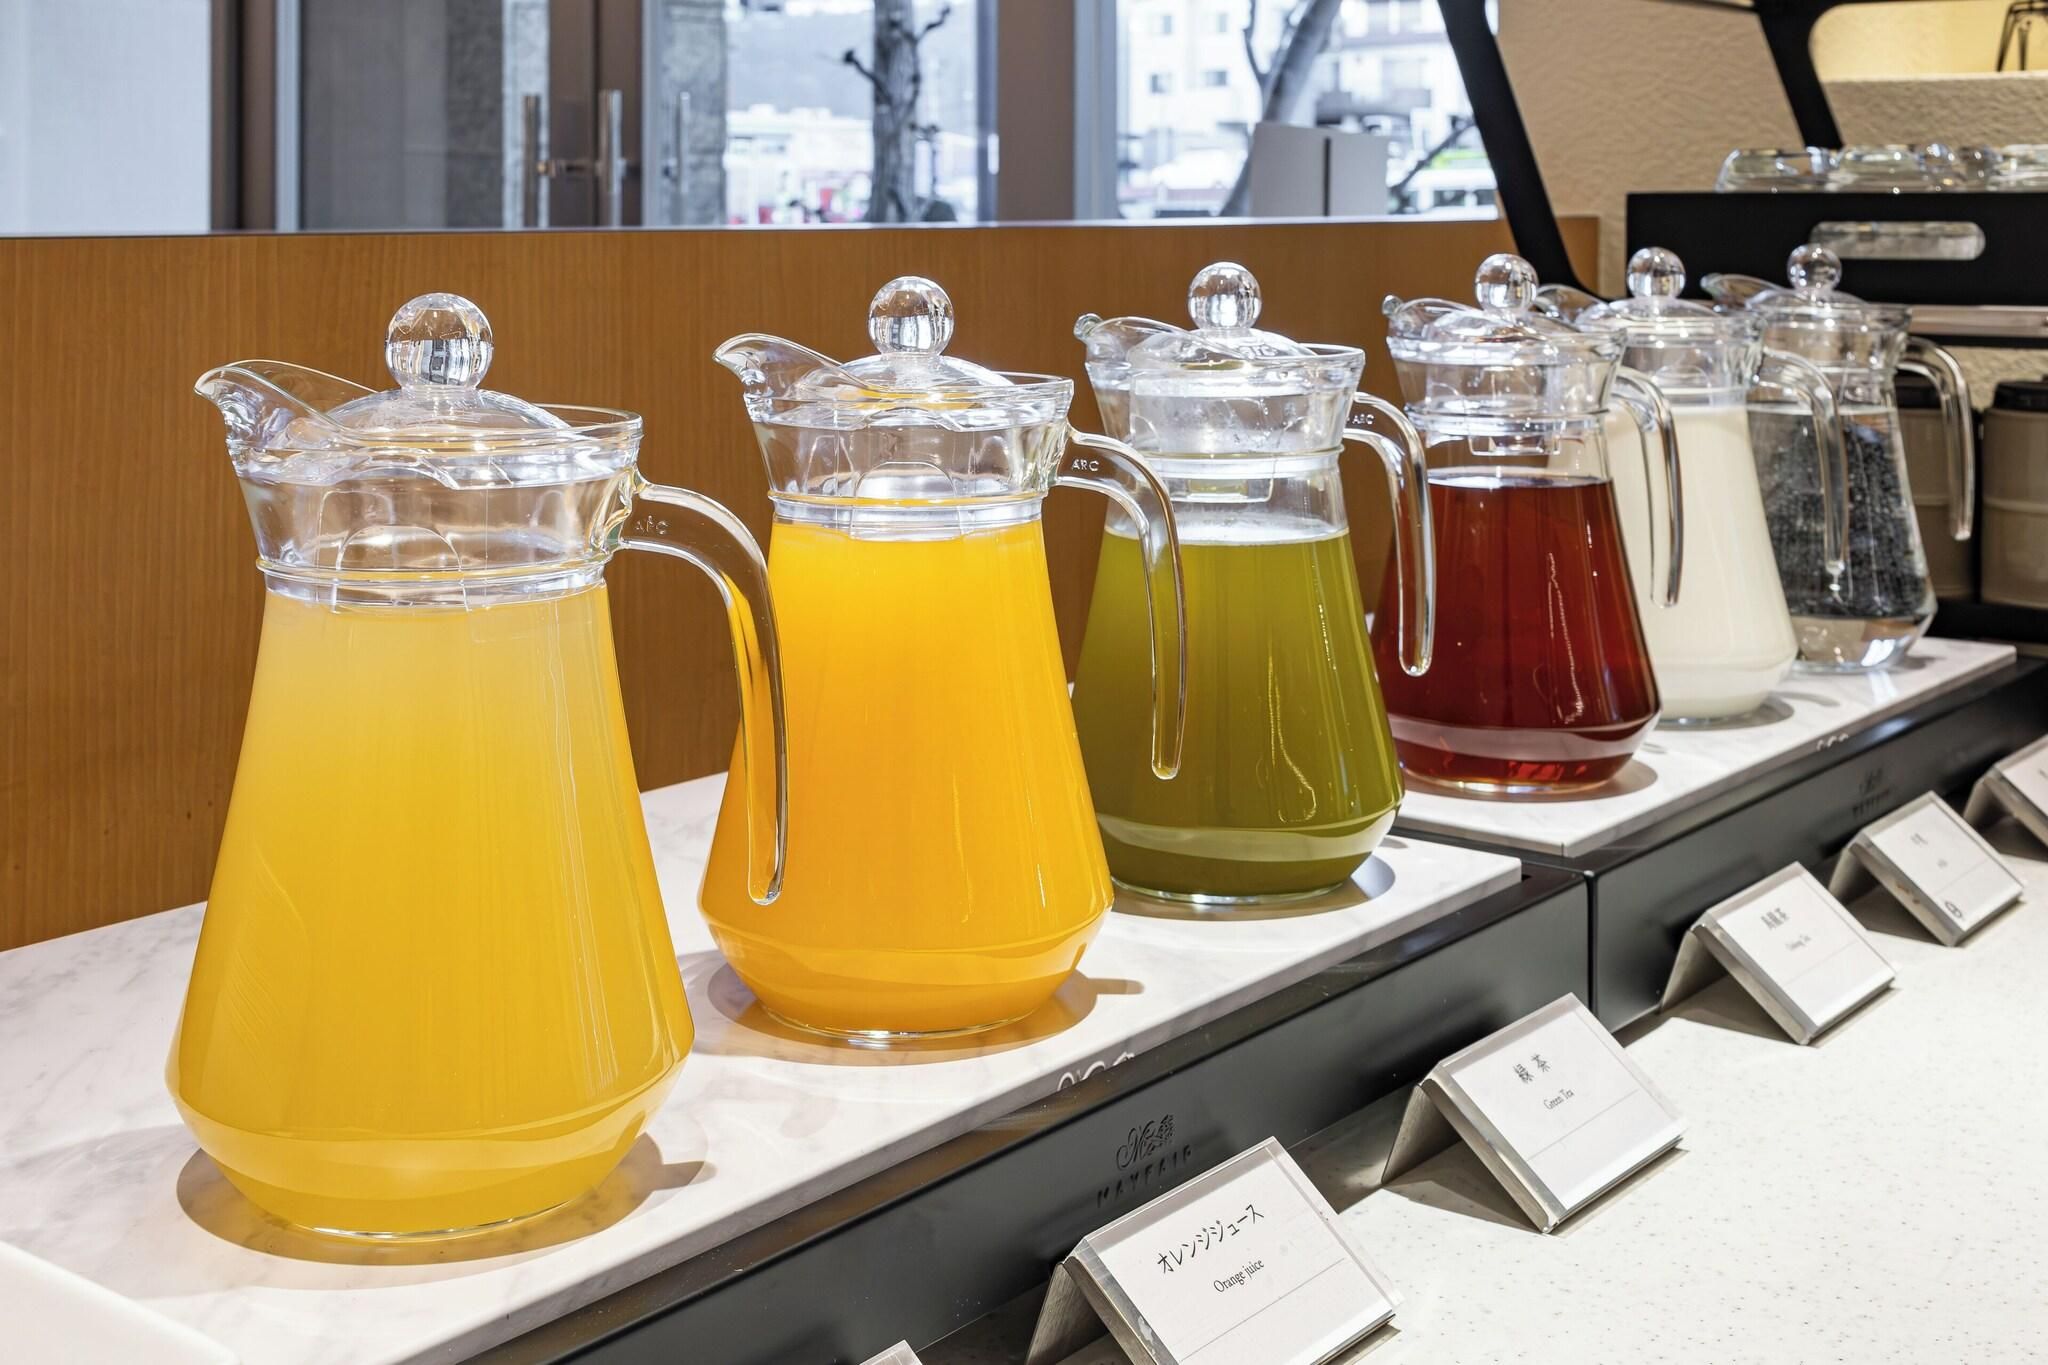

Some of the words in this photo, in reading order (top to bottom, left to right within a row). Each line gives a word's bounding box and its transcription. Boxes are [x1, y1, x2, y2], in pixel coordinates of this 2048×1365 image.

[1071, 458, 1100, 472] ARC
[1543, 1096, 1565, 1110] Green
[1559, 1088, 1575, 1100] Tea
[1157, 1203, 1264, 1274] オレンジジュース
[1213, 1271, 1247, 1293] Orange
[1242, 1259, 1265, 1281] juice
